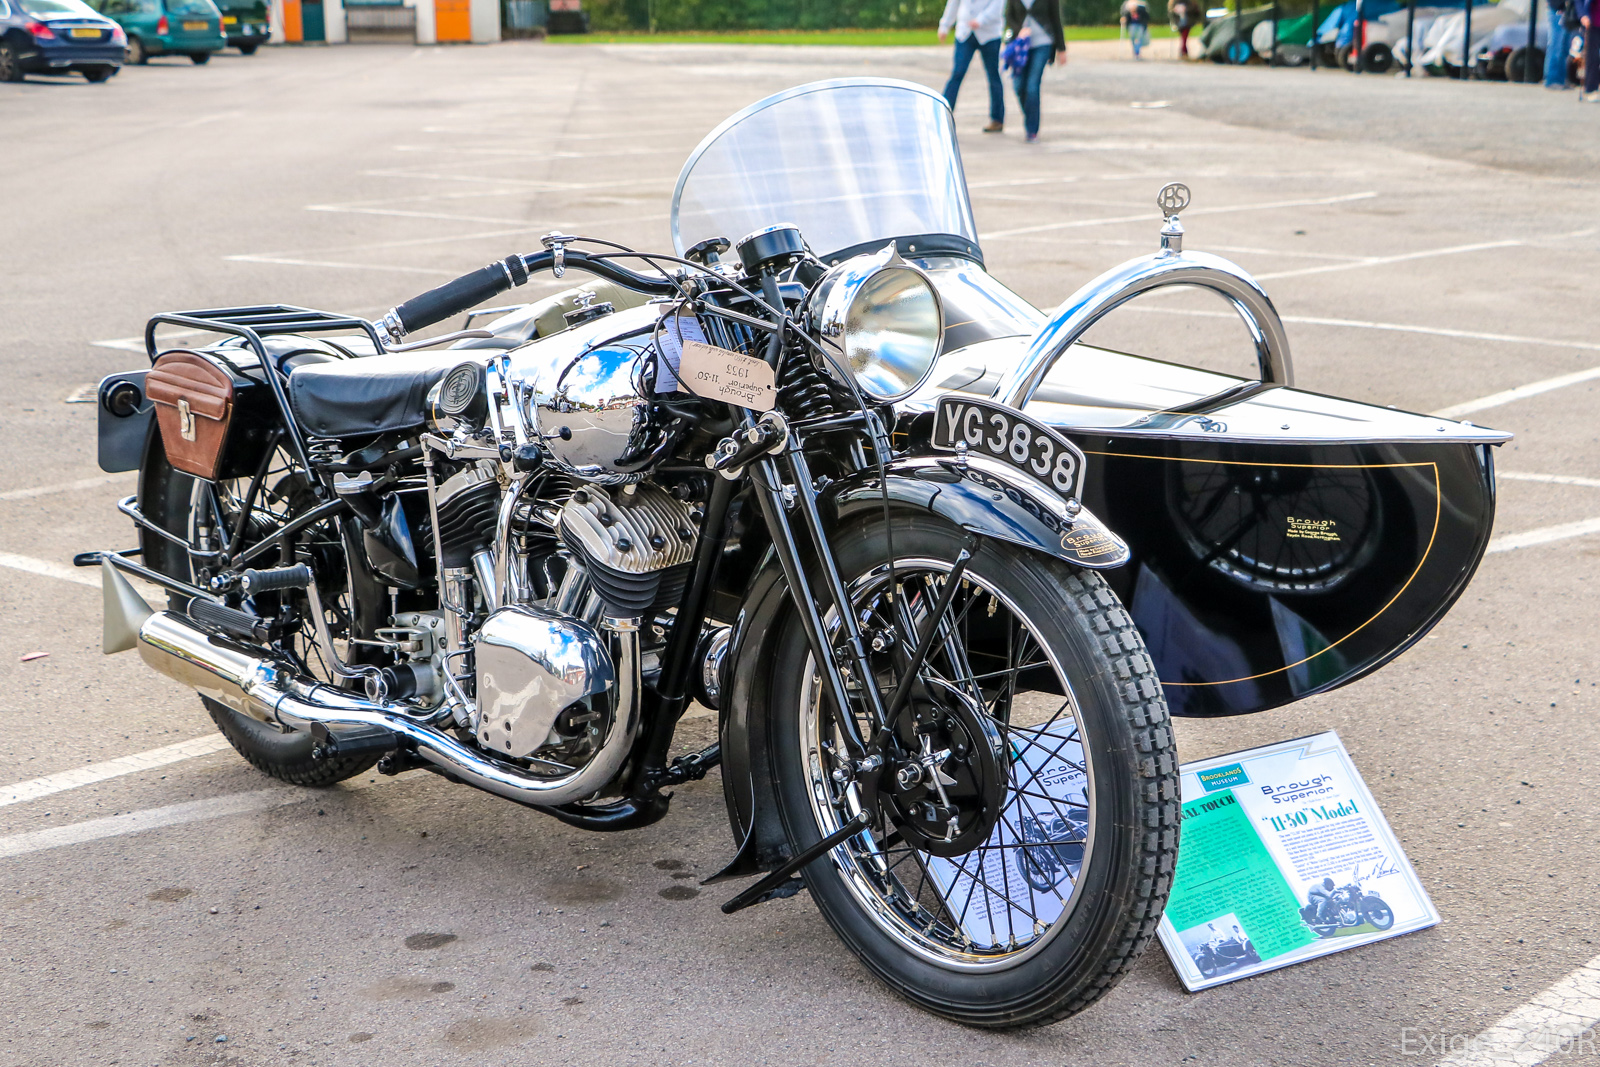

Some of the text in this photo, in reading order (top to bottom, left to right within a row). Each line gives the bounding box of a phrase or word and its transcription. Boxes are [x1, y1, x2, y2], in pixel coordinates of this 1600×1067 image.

[1164, 186, 1184, 208] BS
[726, 364, 749, 378] 1933
[719, 384, 755, 404] Brough
[728, 380, 764, 396] Superior
[944, 403, 1076, 493] YG3838
[1287, 516, 1336, 526] Brough
[1066, 532, 1104, 544] Broug
[1201, 768, 1242, 781] BROOKLANDS
[1211, 776, 1238, 786] MUSEUM
[1261, 774, 1332, 795] Brough
[1200, 795, 1236, 813] TOUCH
[1272, 786, 1334, 804] Superior
[1310, 798, 1359, 823] Model
